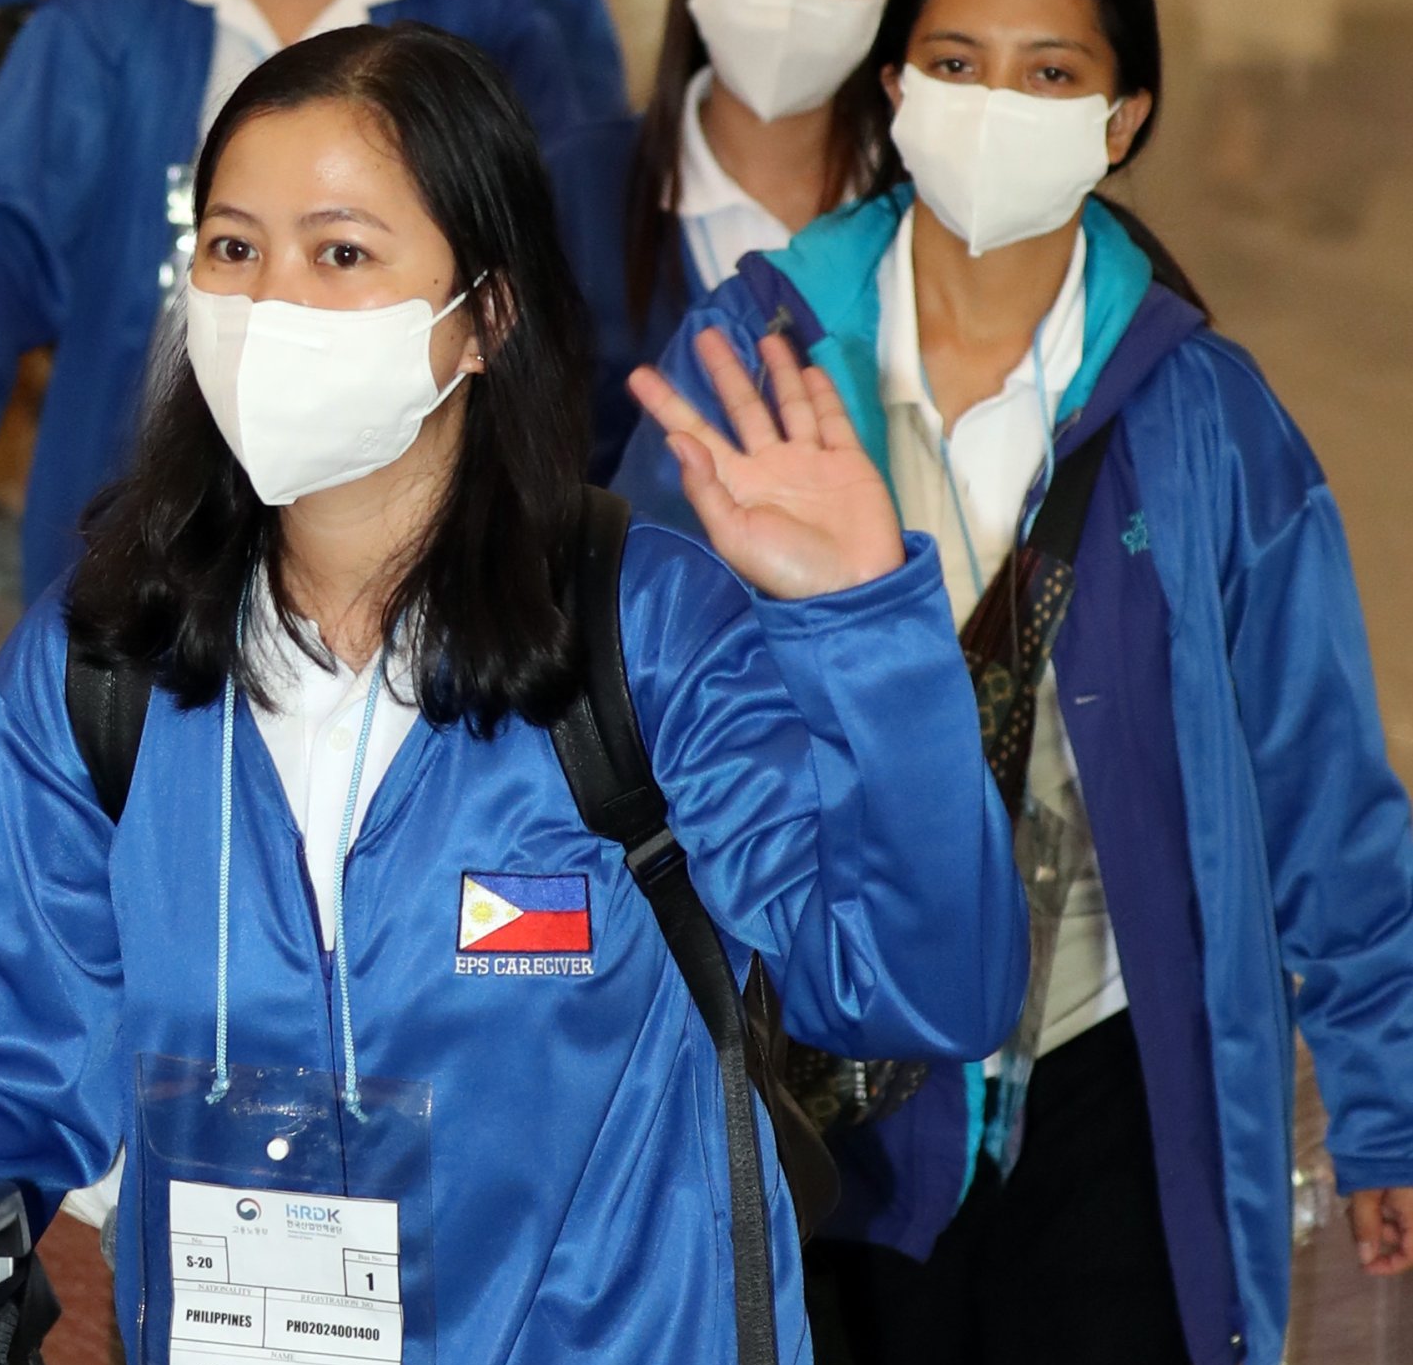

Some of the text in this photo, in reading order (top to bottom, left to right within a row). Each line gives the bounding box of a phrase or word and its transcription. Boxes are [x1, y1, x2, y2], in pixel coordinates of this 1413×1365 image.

[454, 956, 594, 976] EPS CAREGIVER
[286, 1203, 342, 1224] HRDK
[186, 1255, 213, 1269] S-20
[197, 1283, 252, 1296] NATIONALITY
[365, 1272, 374, 1291] 1
[300, 1294, 358, 1308] REGISTRATION
[186, 1309, 252, 1328] PHILIPPINES
[270, 1351, 295, 1362] NAME
